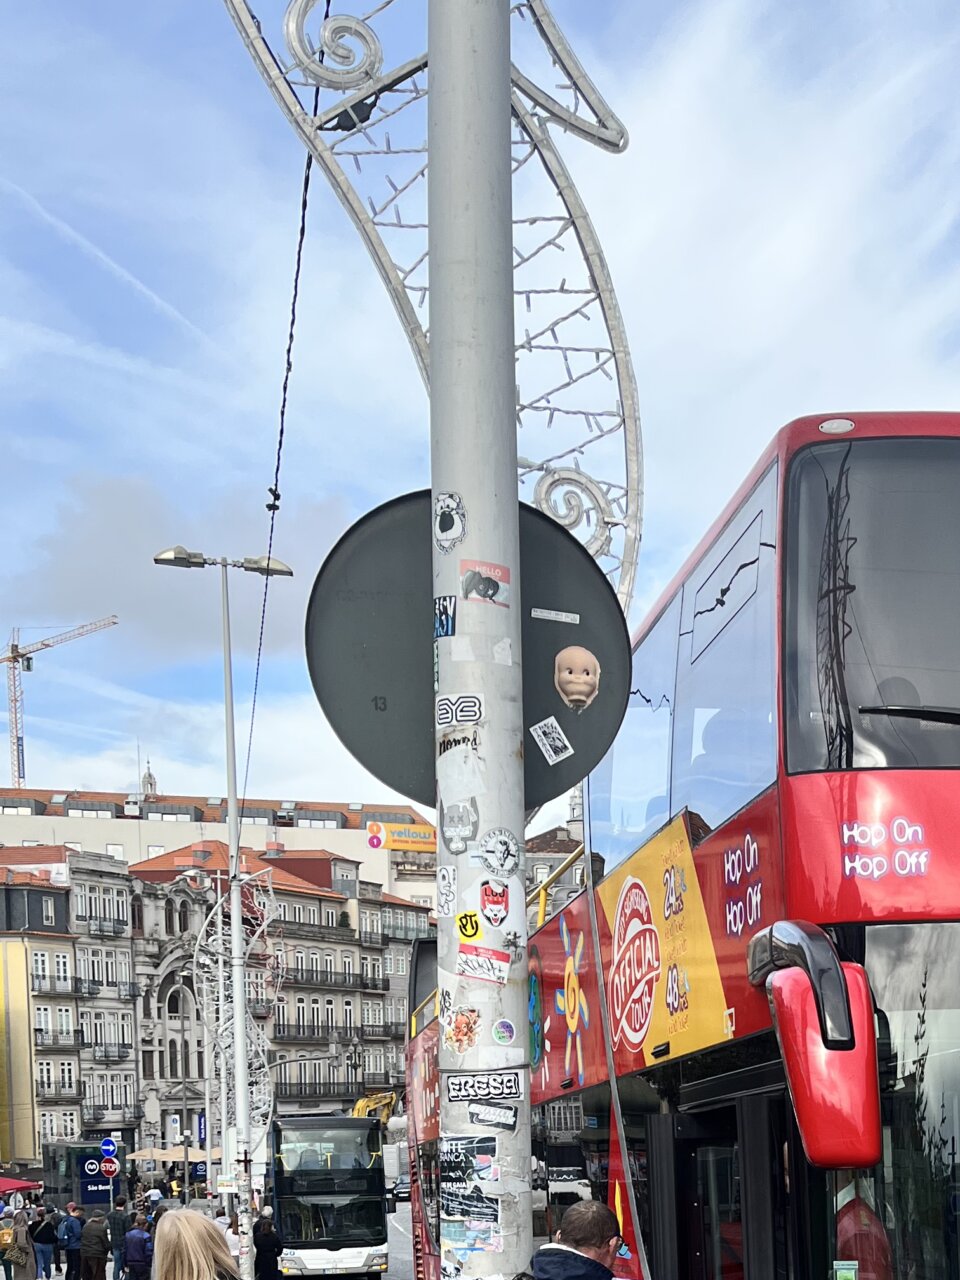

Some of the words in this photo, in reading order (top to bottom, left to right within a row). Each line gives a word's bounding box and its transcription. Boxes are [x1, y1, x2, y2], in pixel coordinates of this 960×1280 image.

[371, 695, 387, 711] 13
[843, 823, 885, 846] Hop
[893, 818, 922, 843] On
[724, 849, 742, 885] Hop
[744, 833, 759, 873] On
[844, 854, 887, 878] Hop
[895, 850, 929, 875] Off
[725, 900, 744, 936] Hop
[746, 883, 762, 925] Off
[613, 931, 660, 1020] OFFICIAL
[631, 985, 651, 1030] TOUR
[448, 1074, 520, 1100] FRESA
[101, 1162, 117, 1171] STOP
